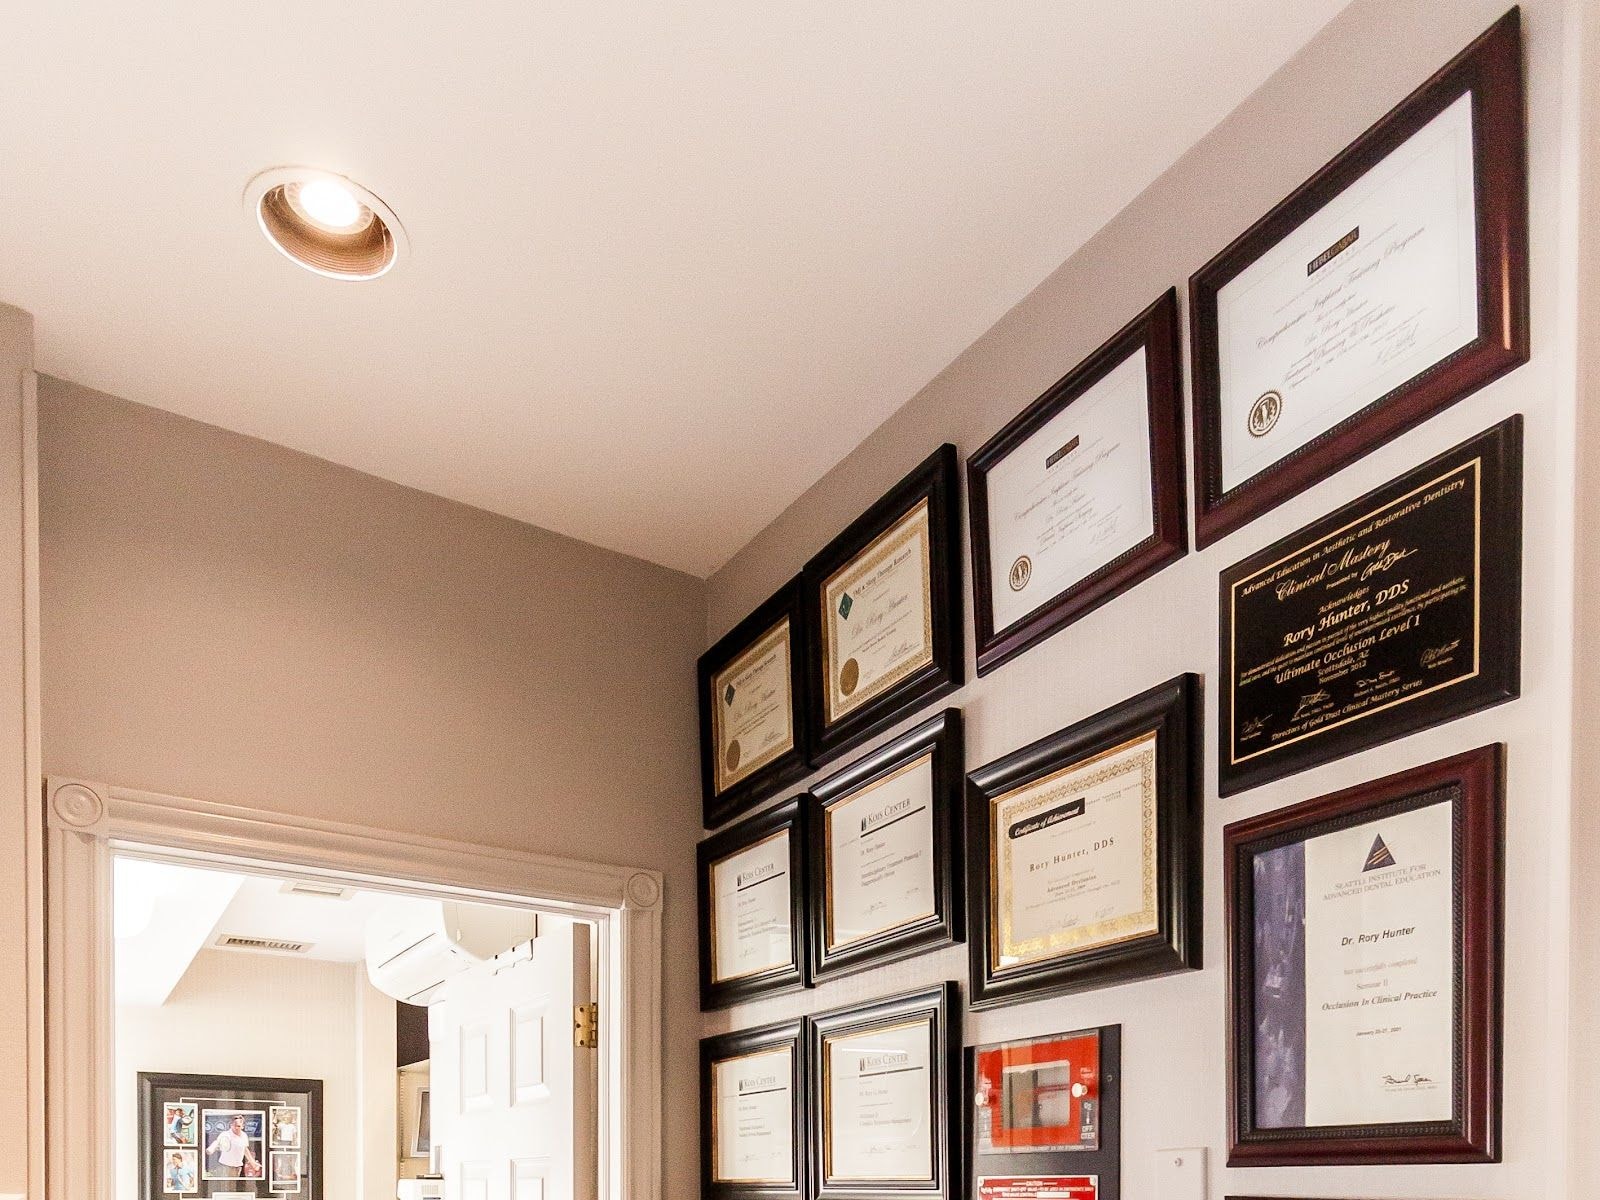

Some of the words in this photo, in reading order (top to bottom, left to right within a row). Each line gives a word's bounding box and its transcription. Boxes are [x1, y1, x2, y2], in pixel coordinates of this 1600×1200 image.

[1241, 572, 1274, 597] Advanced
[1276, 556, 1310, 579] Education
[1312, 551, 1319, 560] in
[1321, 534, 1354, 556] Aesthetic
[1357, 523, 1372, 537] and
[1375, 499, 1420, 529] Restorative
[1423, 477, 1464, 505] Dentistry
[1275, 563, 1326, 601] Clinical
[1327, 537, 1390, 577] Mastery
[1283, 624, 1314, 647] Rory
[1318, 599, 1370, 631] Hunter,
[1375, 578, 1408, 605] DDS
[1318, 585, 1369, 615] Acknowledges
[1276, 658, 1320, 684] Ultimate
[1323, 634, 1375, 664] Occlusion
[1378, 617, 1410, 641] Level
[1319, 667, 1348, 683] November
[1341, 697, 1368, 714] Clinical
[1370, 687, 1399, 702] Mastery
[1402, 679, 1422, 691] Series
[883, 797, 910, 816] CENTER
[1040, 817, 1046, 827] of
[1029, 860, 1048, 872] Rory
[1053, 848, 1088, 864] Hunter,
[1093, 836, 1113, 851] DDS
[1323, 887, 1361, 900] ADVANCED
[1363, 879, 1393, 891] DENTAL
[1394, 869, 1440, 884] EDUCATION
[1368, 868, 1405, 882] INSTITUTE
[1409, 863, 1426, 872] FOR
[1340, 936, 1354, 946] Dr.
[1357, 933, 1379, 943] Rory
[1382, 926, 1414, 938] Hunter
[1321, 1000, 1359, 1010] Occlusion
[1360, 997, 1369, 1006] In
[1370, 993, 1402, 1004] Clinical
[1403, 990, 1437, 1000] Practice
